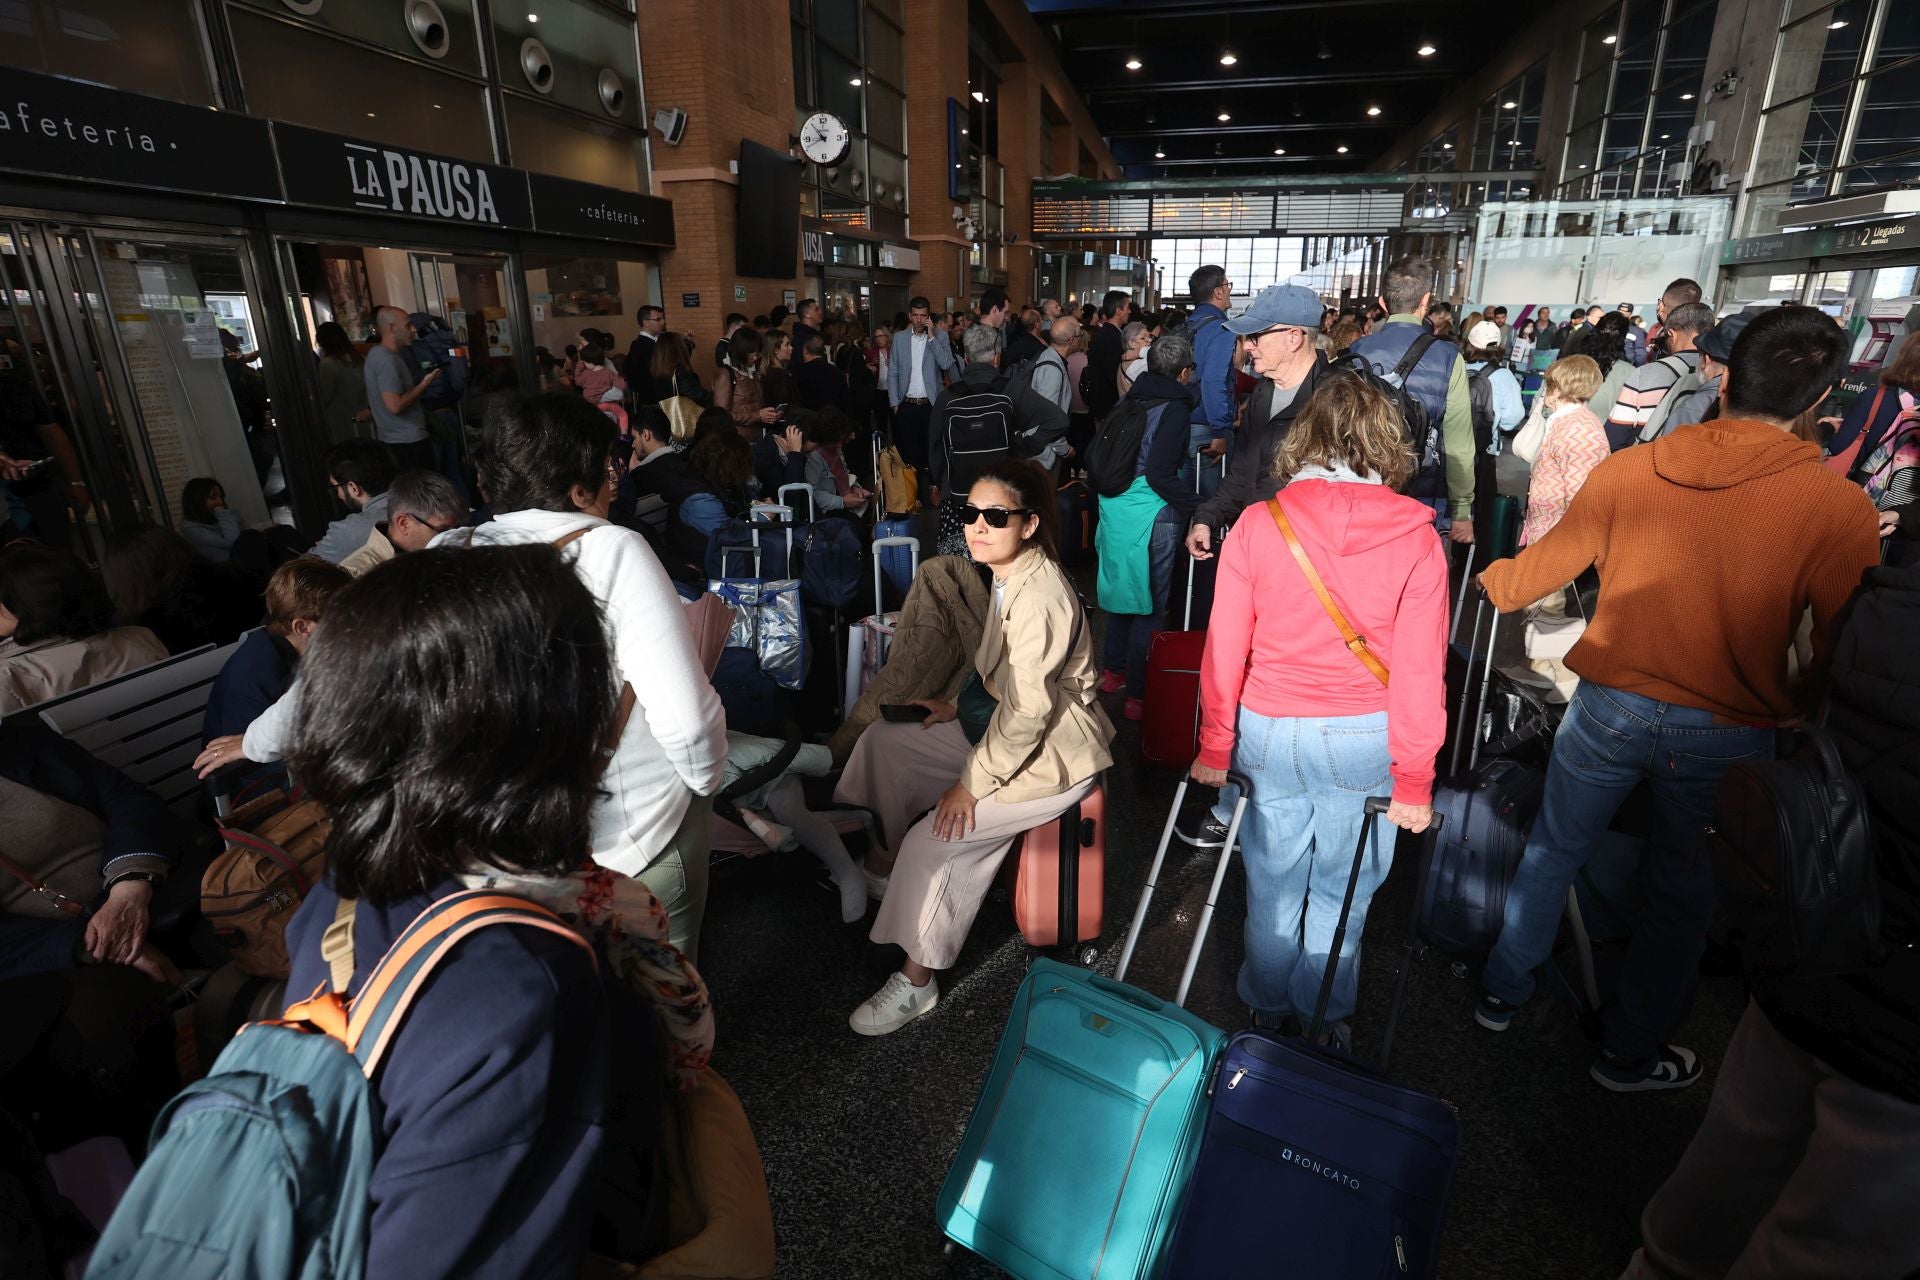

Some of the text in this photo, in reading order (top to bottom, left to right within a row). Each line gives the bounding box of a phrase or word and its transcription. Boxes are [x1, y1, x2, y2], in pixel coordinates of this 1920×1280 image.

[346, 150, 500, 224] LA PAUSA
[801, 231, 824, 262] USA
[1873, 225, 1906, 238] Llegadas
[1843, 381, 1869, 394] renfe
[1294, 1154, 1360, 1190] RONCATO
